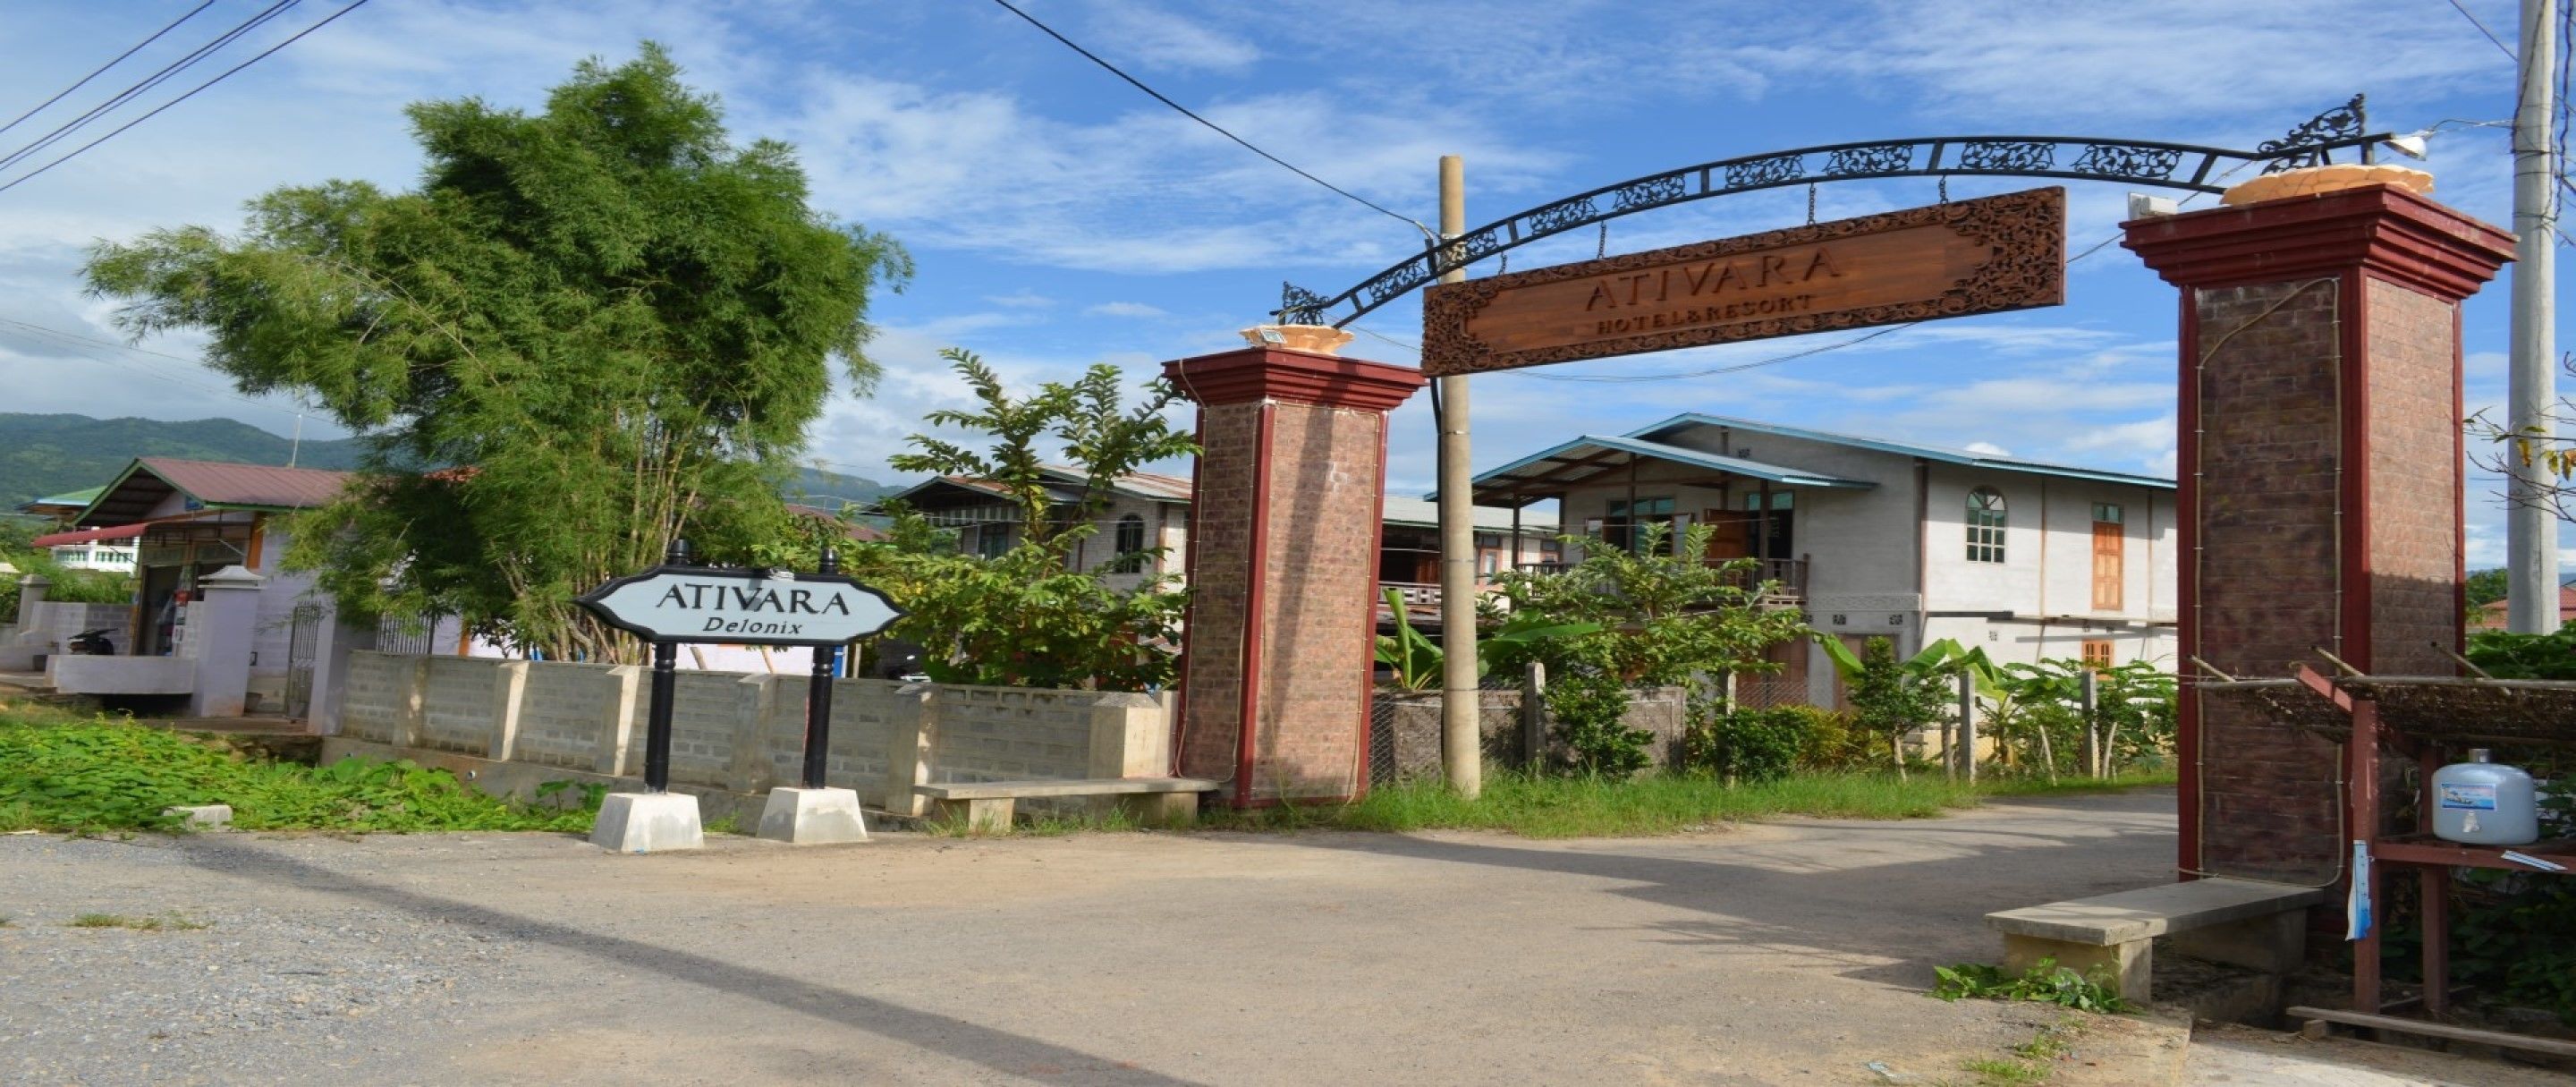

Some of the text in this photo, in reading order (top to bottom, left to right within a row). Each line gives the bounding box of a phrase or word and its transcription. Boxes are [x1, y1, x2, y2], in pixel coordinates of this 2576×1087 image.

[1585, 247, 1842, 311] ATIVARA
[656, 583, 850, 616] ATIVARA
[702, 616, 803, 634] Delonix
